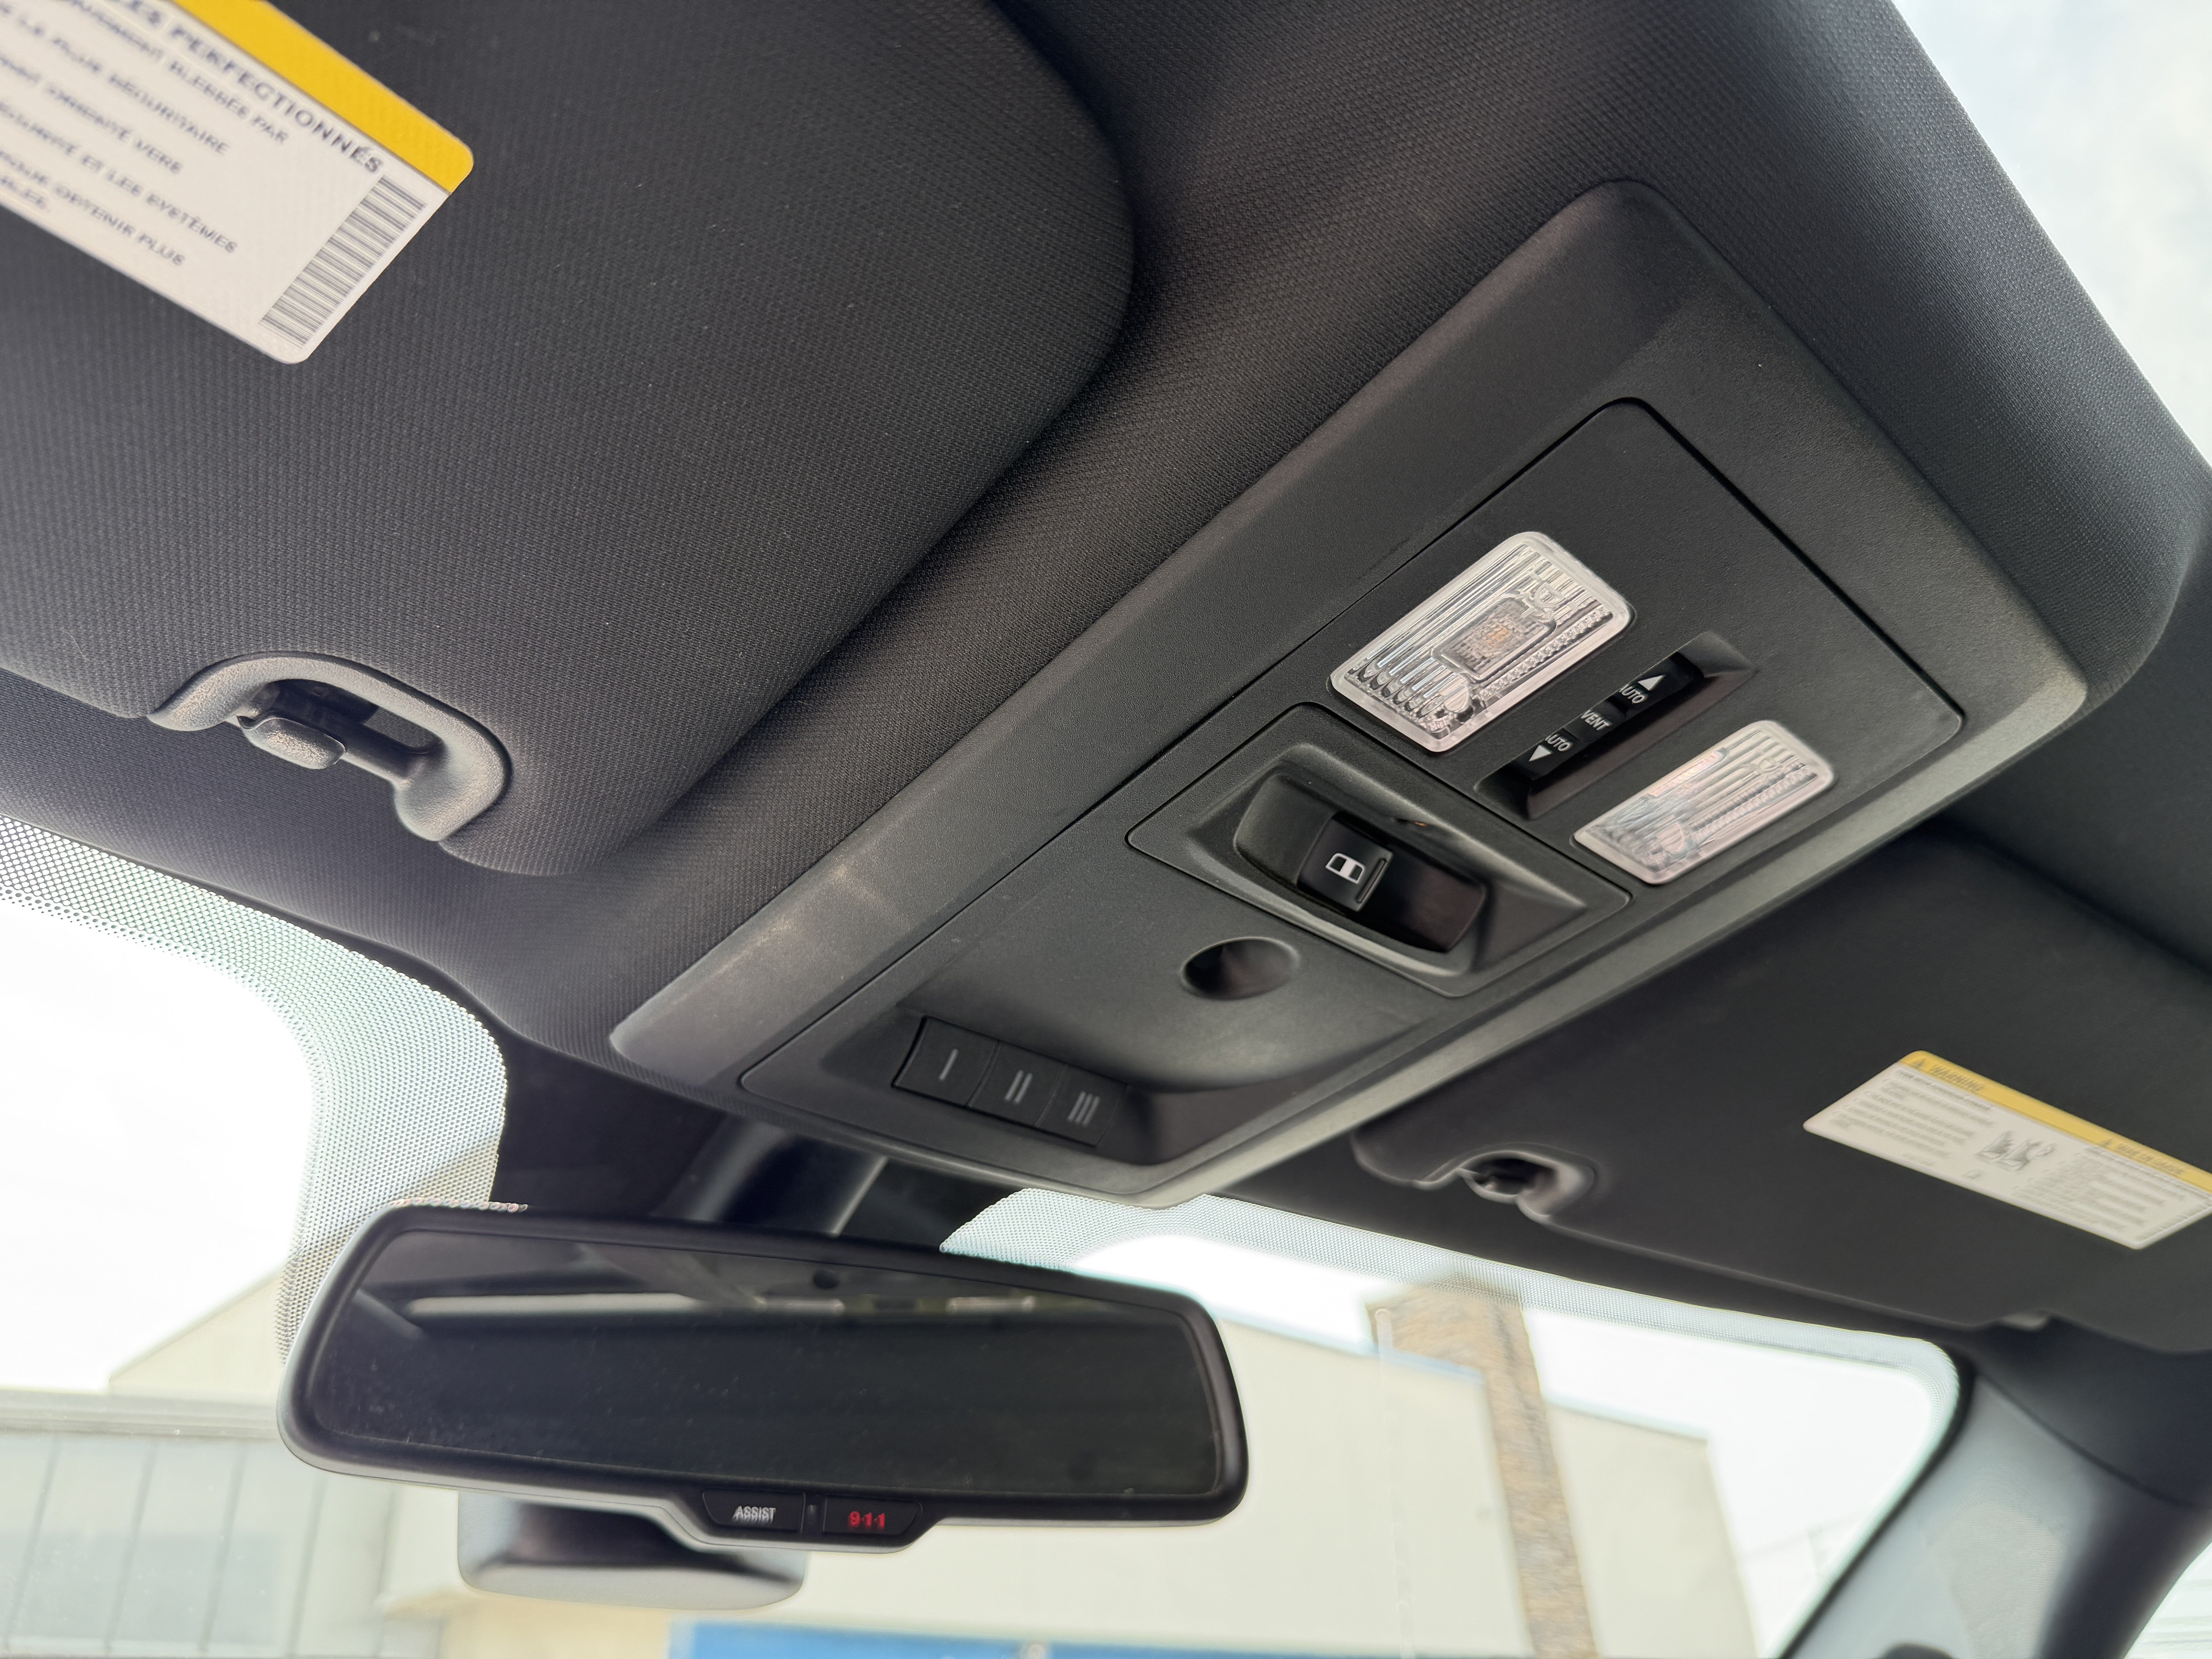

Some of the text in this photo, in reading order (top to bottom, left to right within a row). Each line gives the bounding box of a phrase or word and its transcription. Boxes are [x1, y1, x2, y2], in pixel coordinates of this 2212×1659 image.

[108, 73, 230, 154] SÉCURITAIRE
[169, 23, 384, 173] PERFECTIONNÉS
[136, 137, 182, 174] VERS
[251, 115, 289, 143] PAR
[54, 182, 136, 236] OBTENIR
[138, 232, 185, 265] PLUS
[81, 153, 105, 173] ET
[105, 170, 142, 197] LES
[146, 193, 237, 253] SYSTÈMES
[1581, 709, 1612, 731] VENT
[732, 1505, 886, 1528] ASSIST 911
